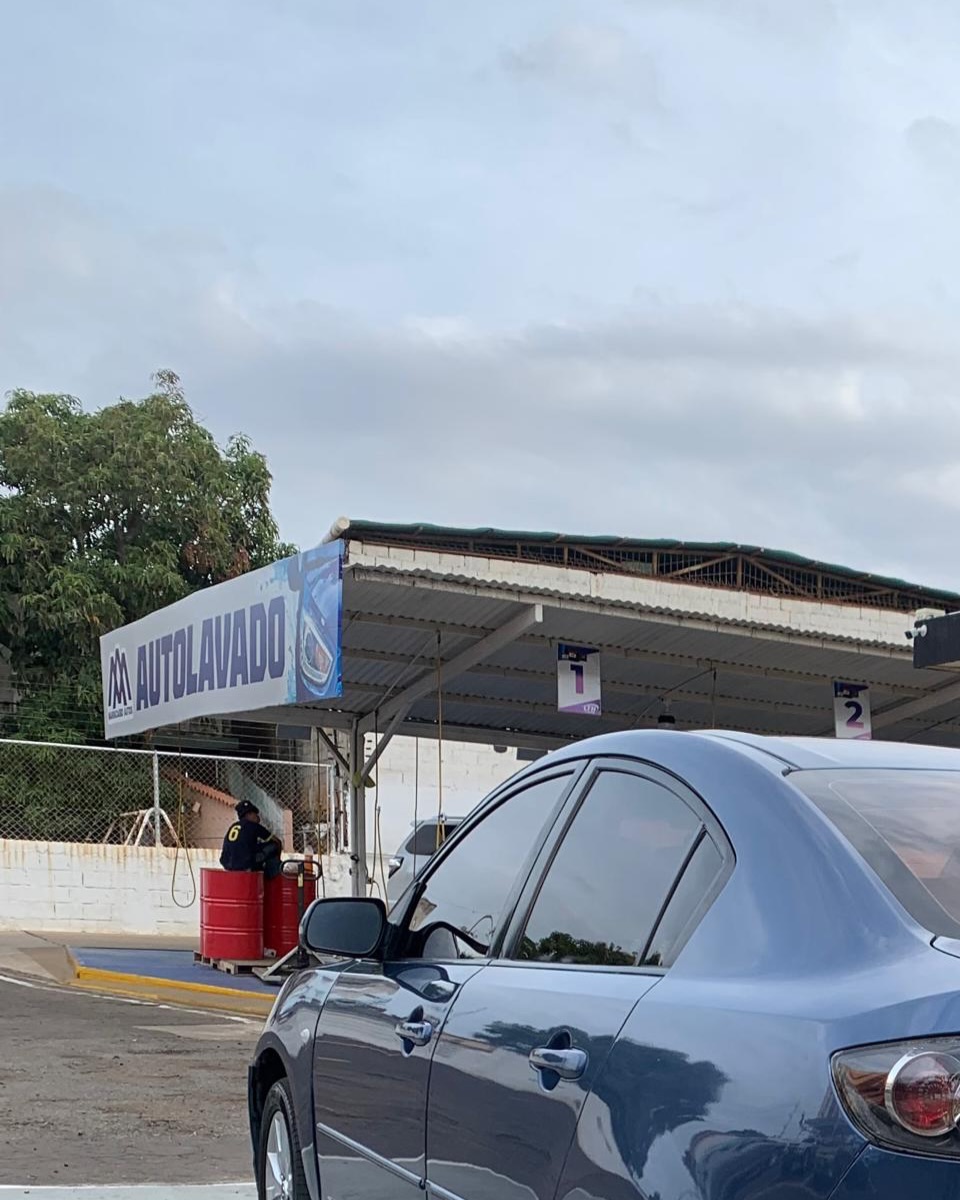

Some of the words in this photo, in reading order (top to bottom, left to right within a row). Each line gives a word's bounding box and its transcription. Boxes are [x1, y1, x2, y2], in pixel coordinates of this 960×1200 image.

[136, 595, 286, 711] AUTOLAVADO
[570, 664, 584, 694] 1
[844, 700, 865, 729] 2
[228, 825, 242, 842] 6
